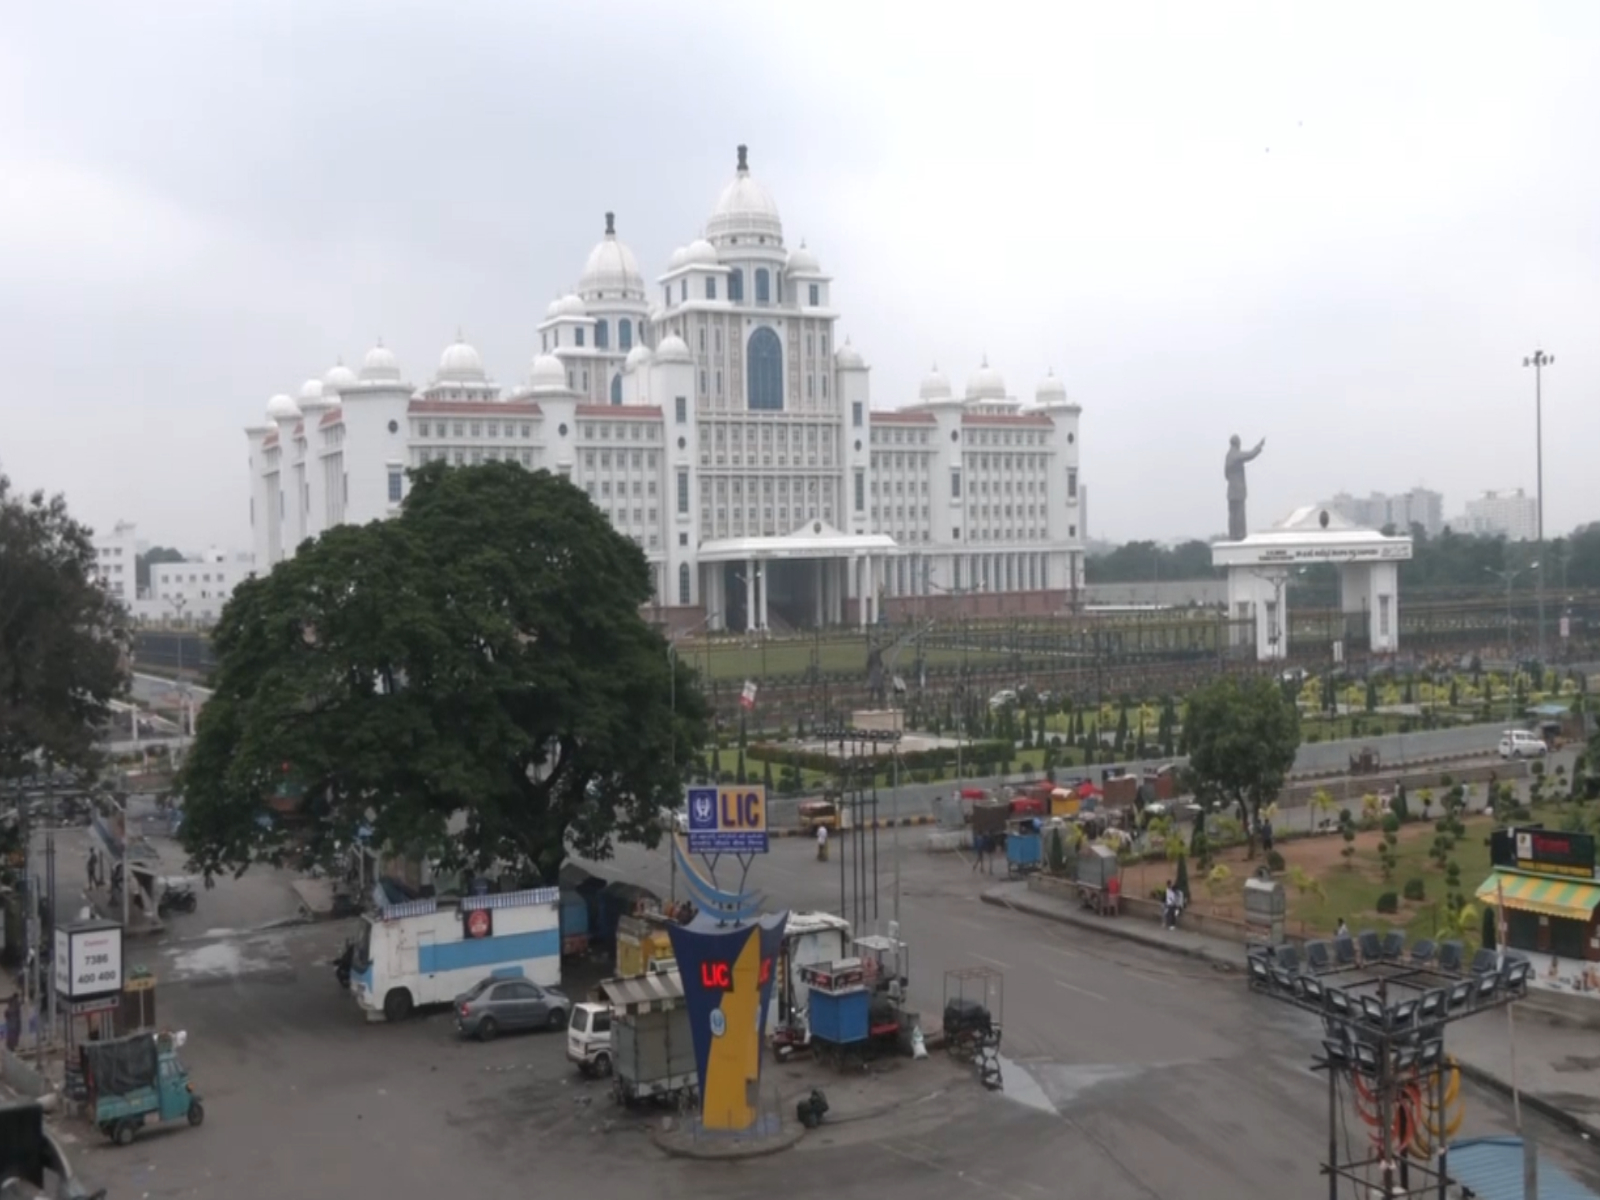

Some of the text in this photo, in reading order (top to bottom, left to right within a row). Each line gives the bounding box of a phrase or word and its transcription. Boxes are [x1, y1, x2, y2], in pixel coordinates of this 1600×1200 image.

[721, 793, 759, 827] LIC
[78, 970, 116, 984] 400 400
[702, 963, 729, 987] LIC
